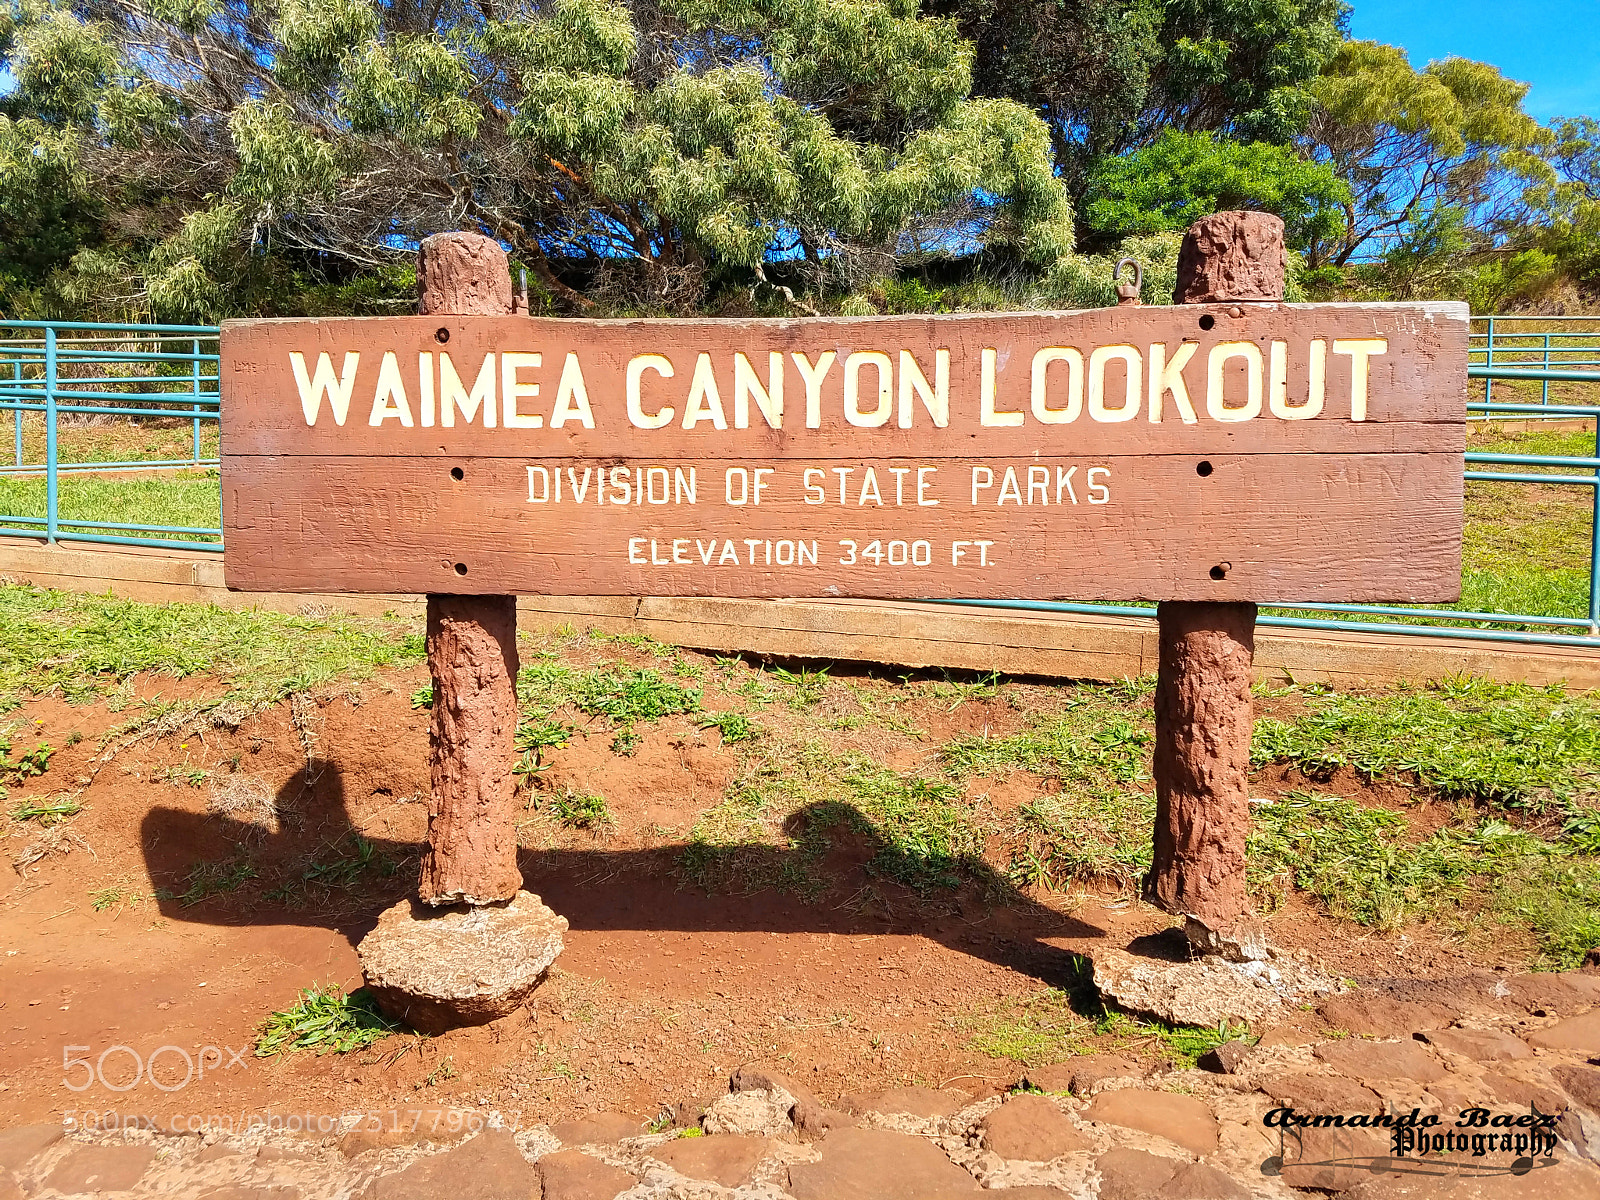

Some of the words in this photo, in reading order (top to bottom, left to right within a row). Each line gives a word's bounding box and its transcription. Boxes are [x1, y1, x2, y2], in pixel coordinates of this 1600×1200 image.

[289, 350, 596, 430] WAIMEA
[625, 350, 951, 431] CANYON
[979, 337, 1389, 427] LOOKOUT
[526, 465, 698, 505] DIVISION
[724, 467, 776, 506] OF
[802, 465, 940, 508] STATE
[970, 465, 1112, 507] PARKS
[627, 537, 820, 567] ELEVATION
[838, 538, 933, 568] 3400
[951, 539, 997, 568] FT.
